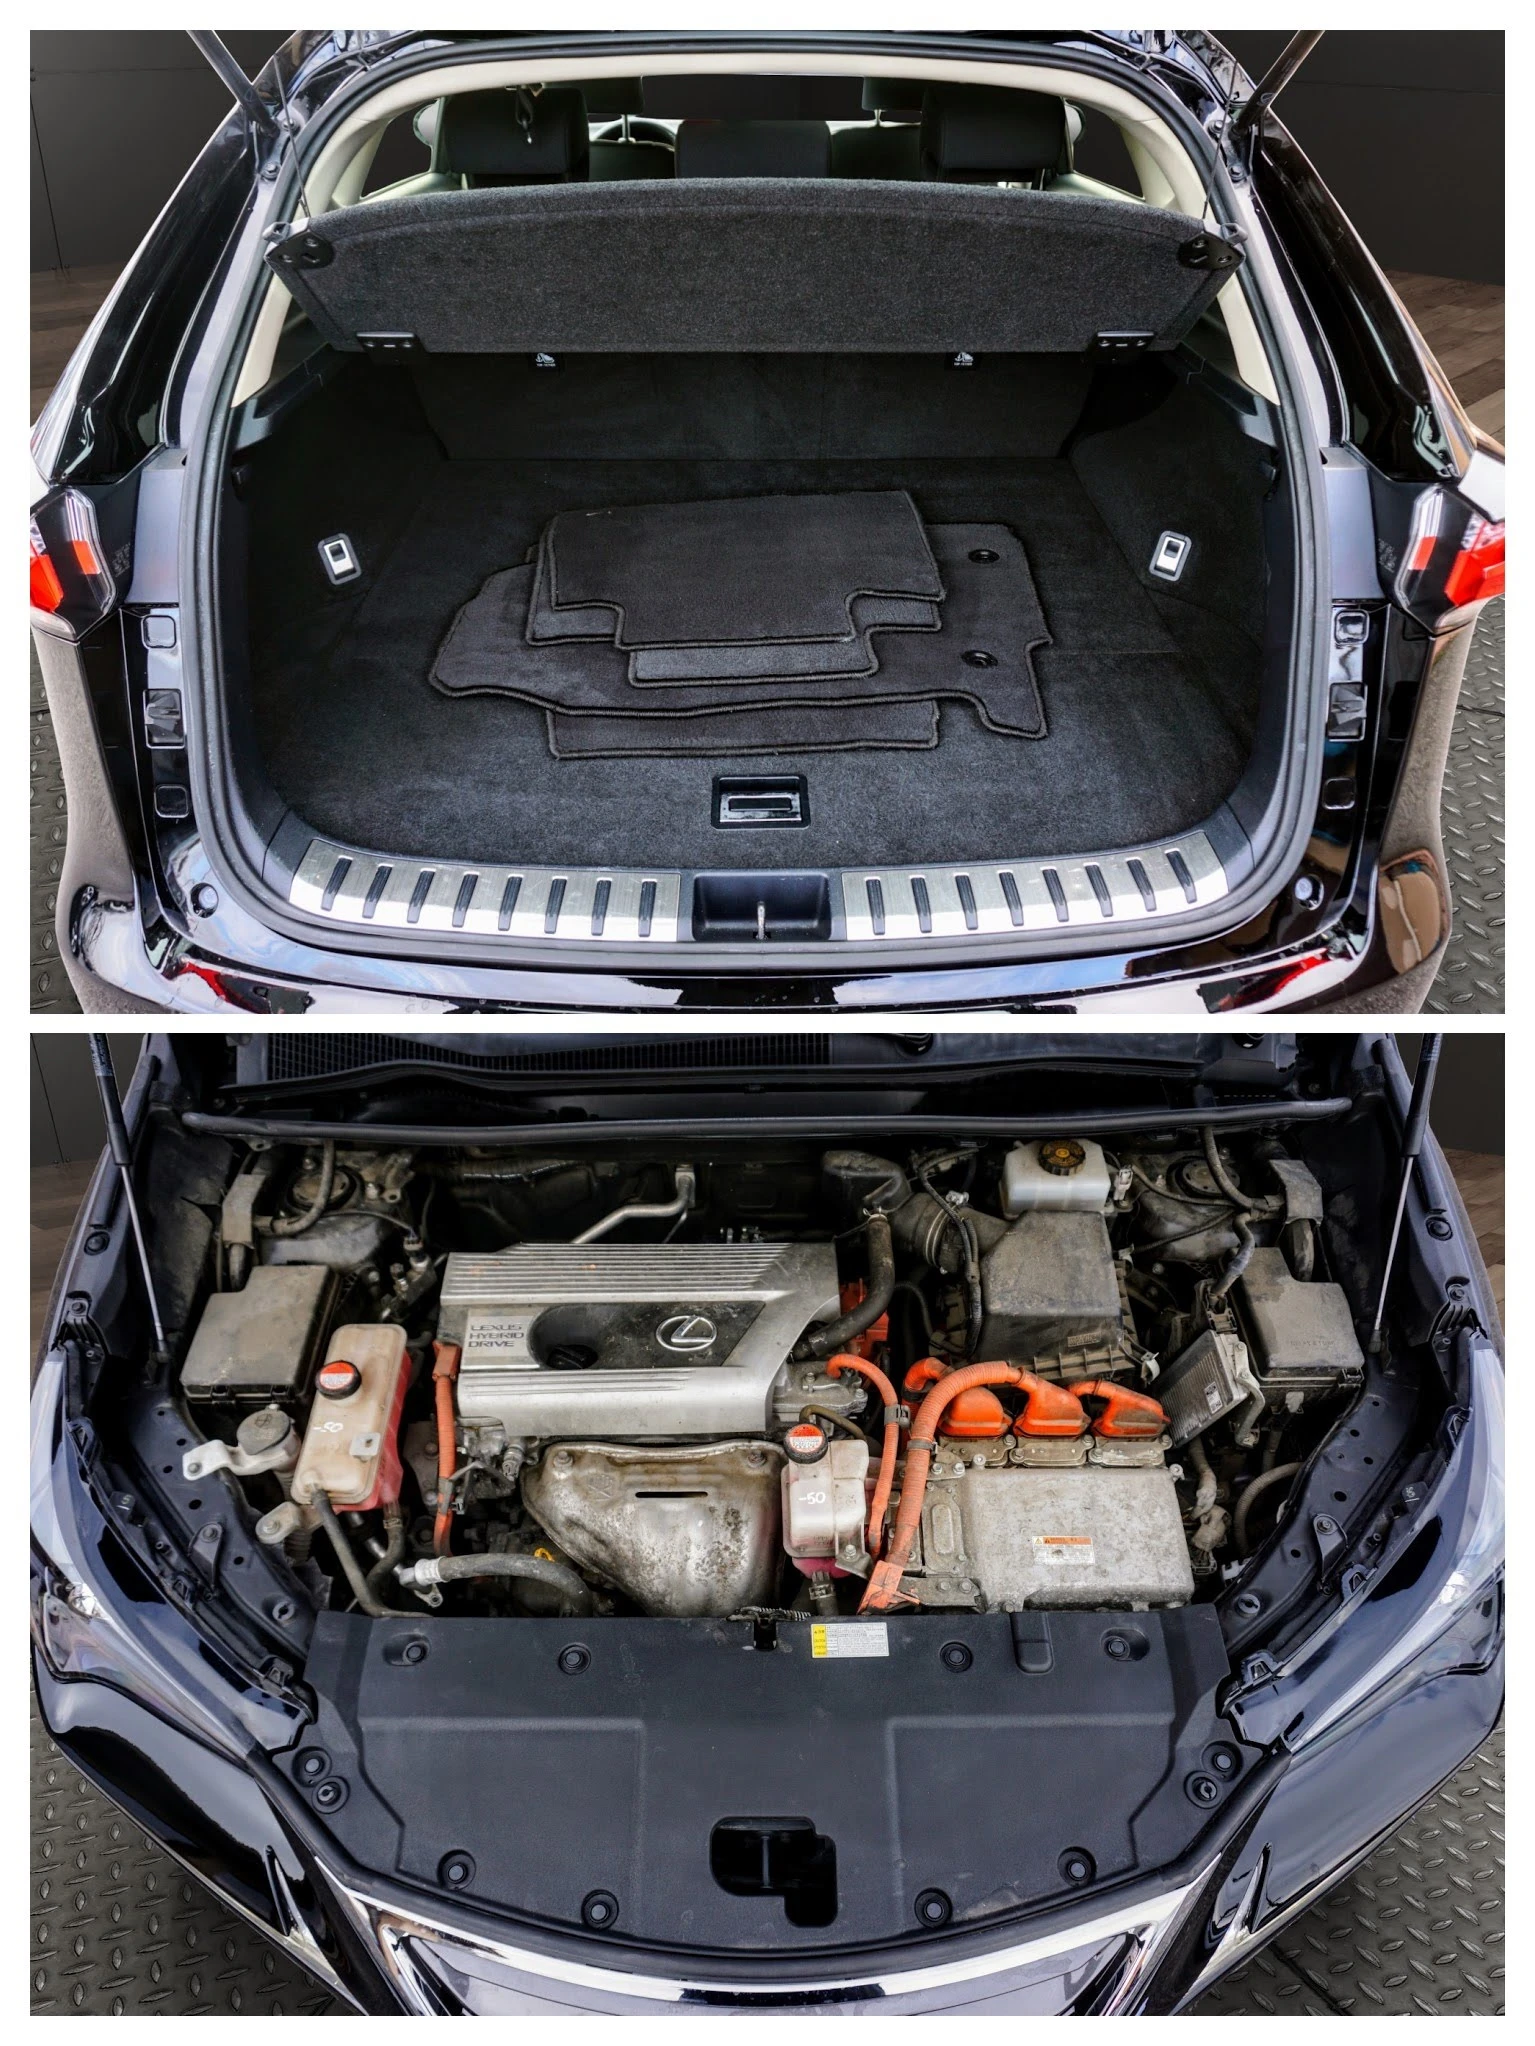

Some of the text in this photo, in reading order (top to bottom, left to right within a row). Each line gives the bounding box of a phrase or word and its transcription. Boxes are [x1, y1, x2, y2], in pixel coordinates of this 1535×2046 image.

[471, 1323, 523, 1331] LEXUS
[469, 1332, 525, 1340] HYBRID
[468, 1340, 515, 1348] DRIVE
[798, 1491, 827, 1505] -50
